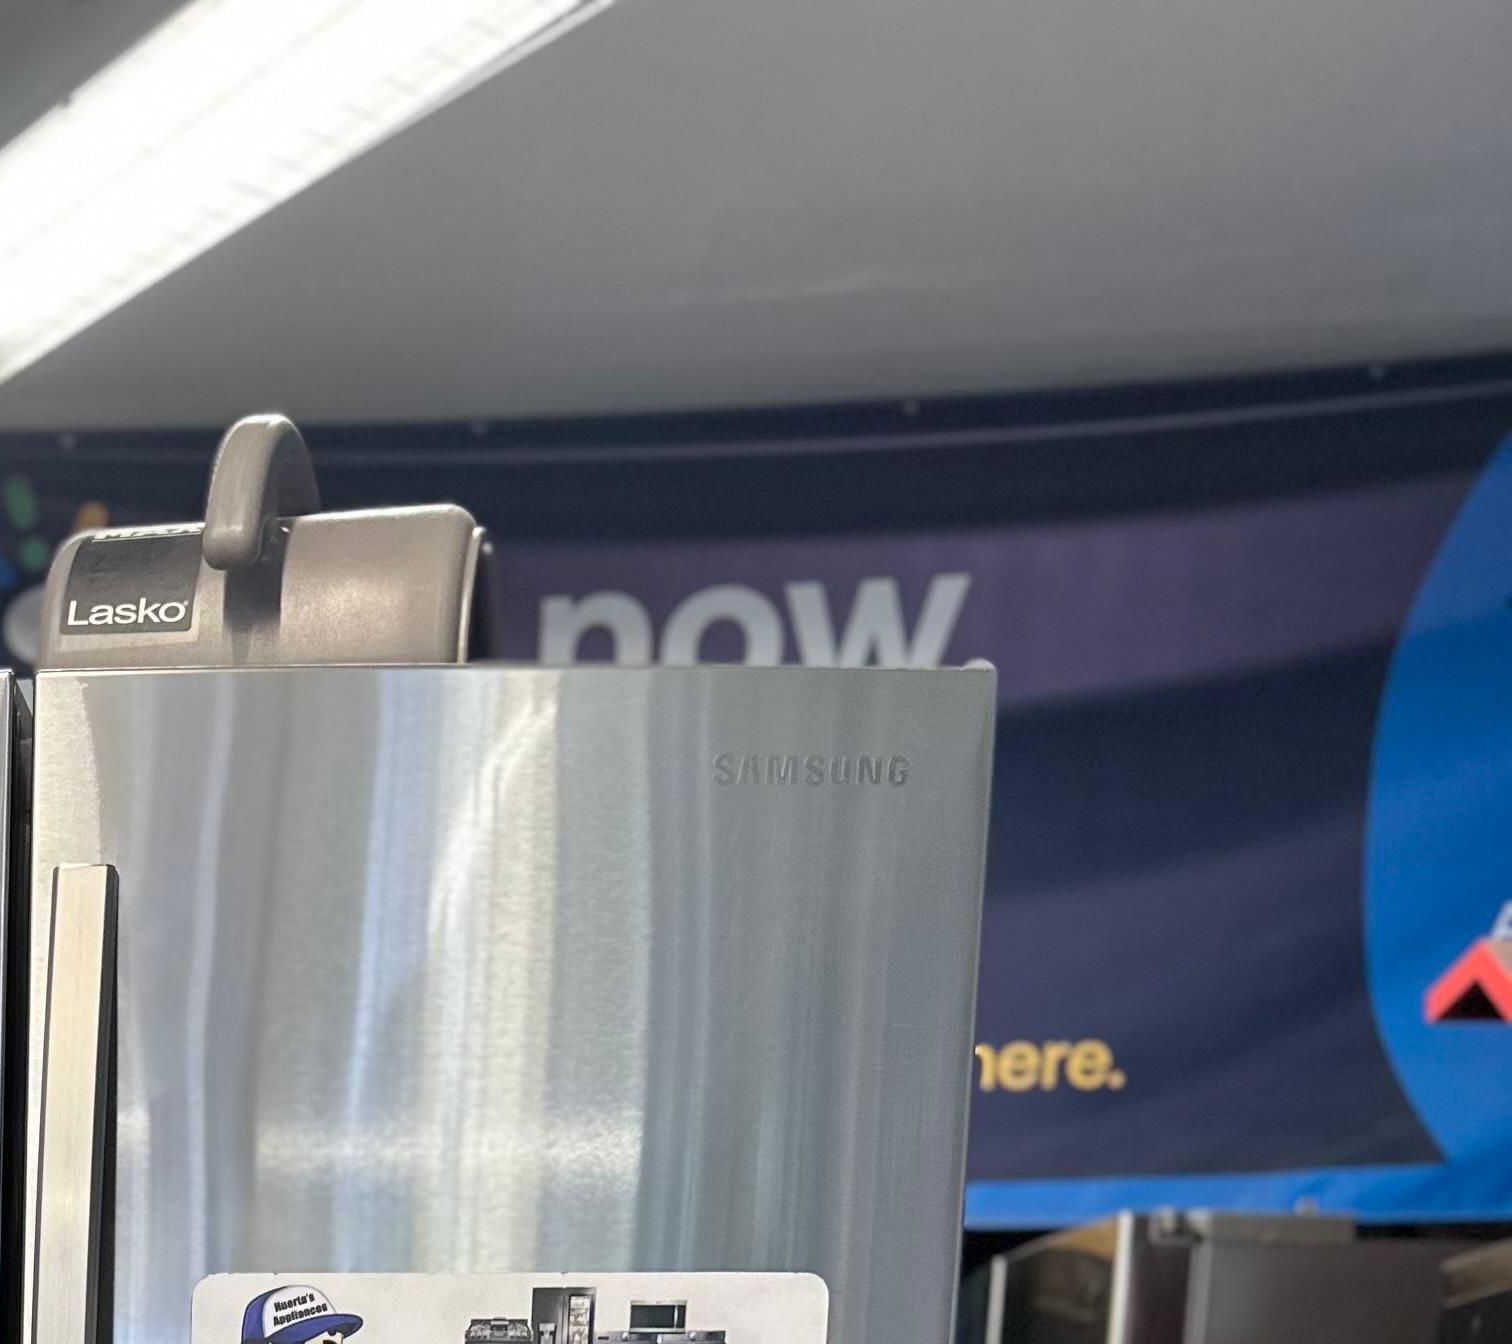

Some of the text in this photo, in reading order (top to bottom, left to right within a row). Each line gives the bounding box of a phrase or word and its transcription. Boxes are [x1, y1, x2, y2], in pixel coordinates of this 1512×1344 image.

[66, 598, 186, 626] Lasko
[538, 572, 972, 668] now
[712, 753, 910, 788] SAMSUNG
